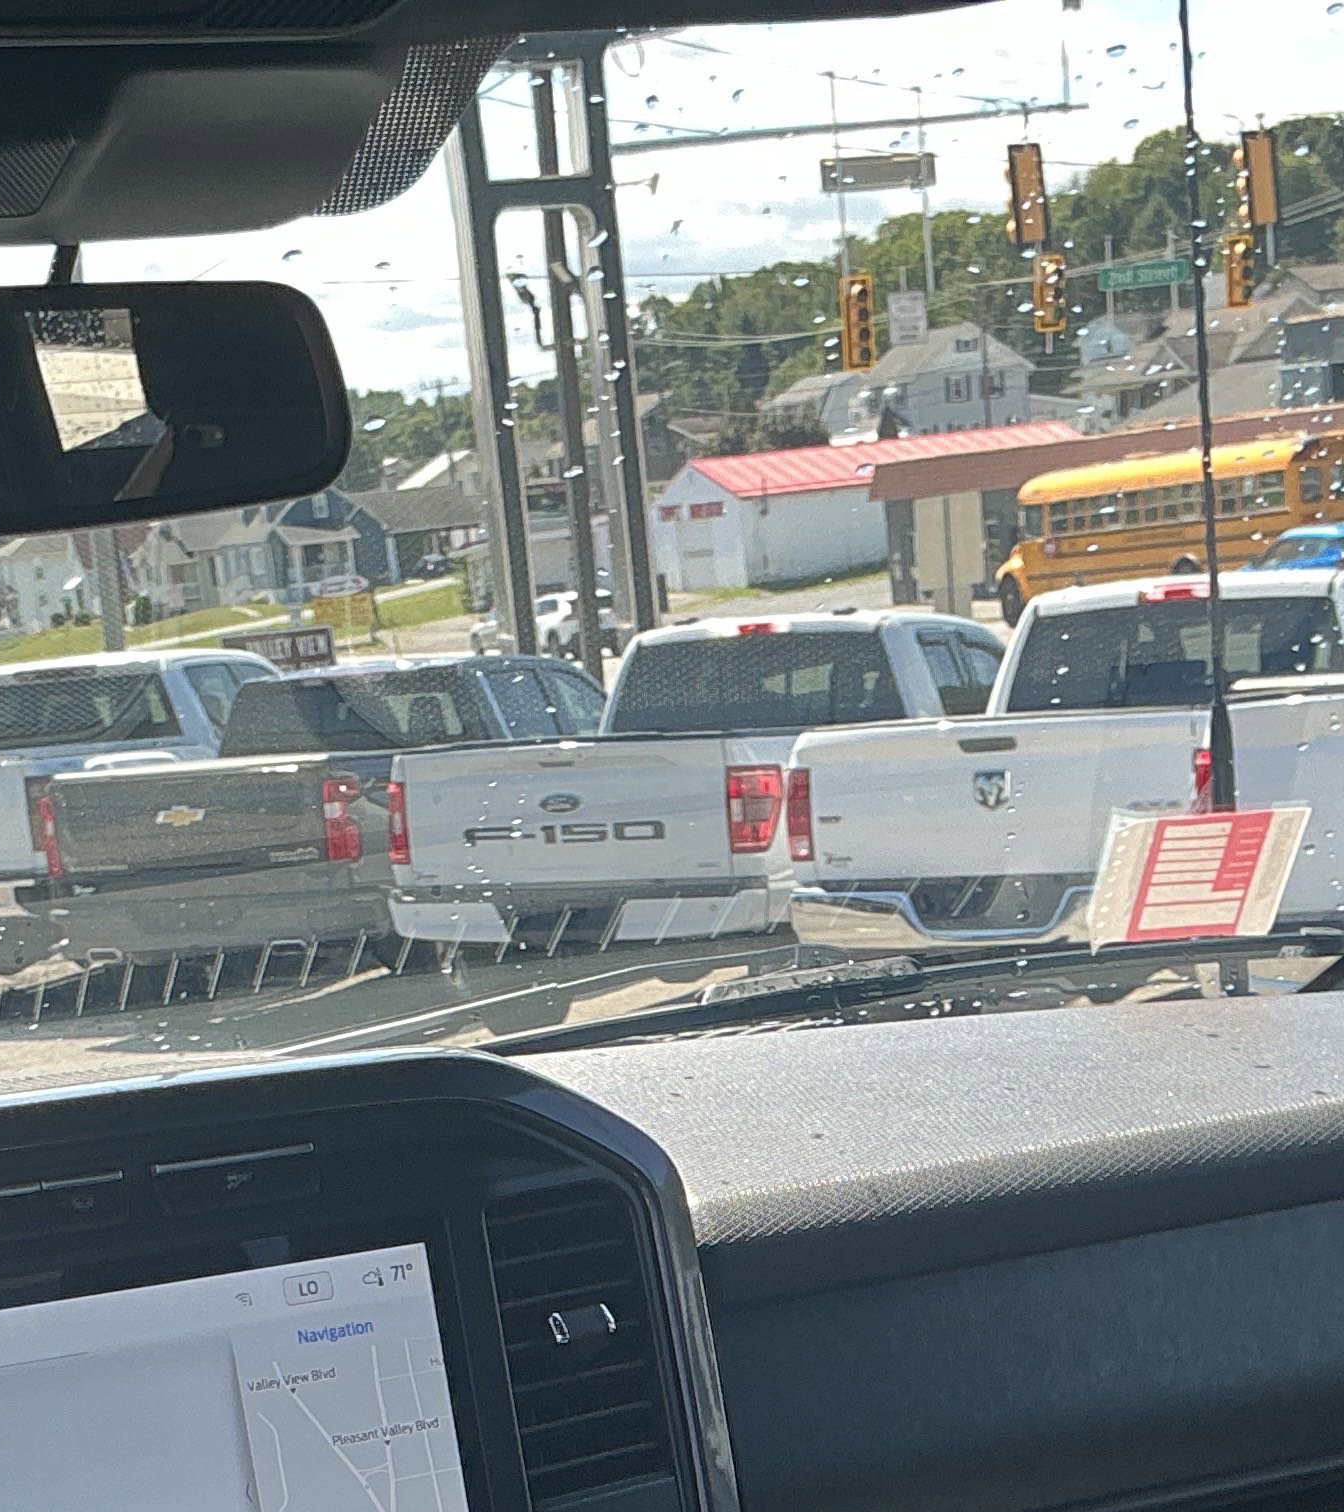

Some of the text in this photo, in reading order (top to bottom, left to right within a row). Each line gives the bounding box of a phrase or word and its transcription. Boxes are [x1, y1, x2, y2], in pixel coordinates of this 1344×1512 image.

[463, 820, 666, 846] F-150
[298, 1263, 413, 1297] LO 71°
[297, 1320, 374, 1344] Navigation
[247, 1366, 337, 1393] Valley View Blvd
[332, 1416, 440, 1446] Pleasant Valley Blvd
